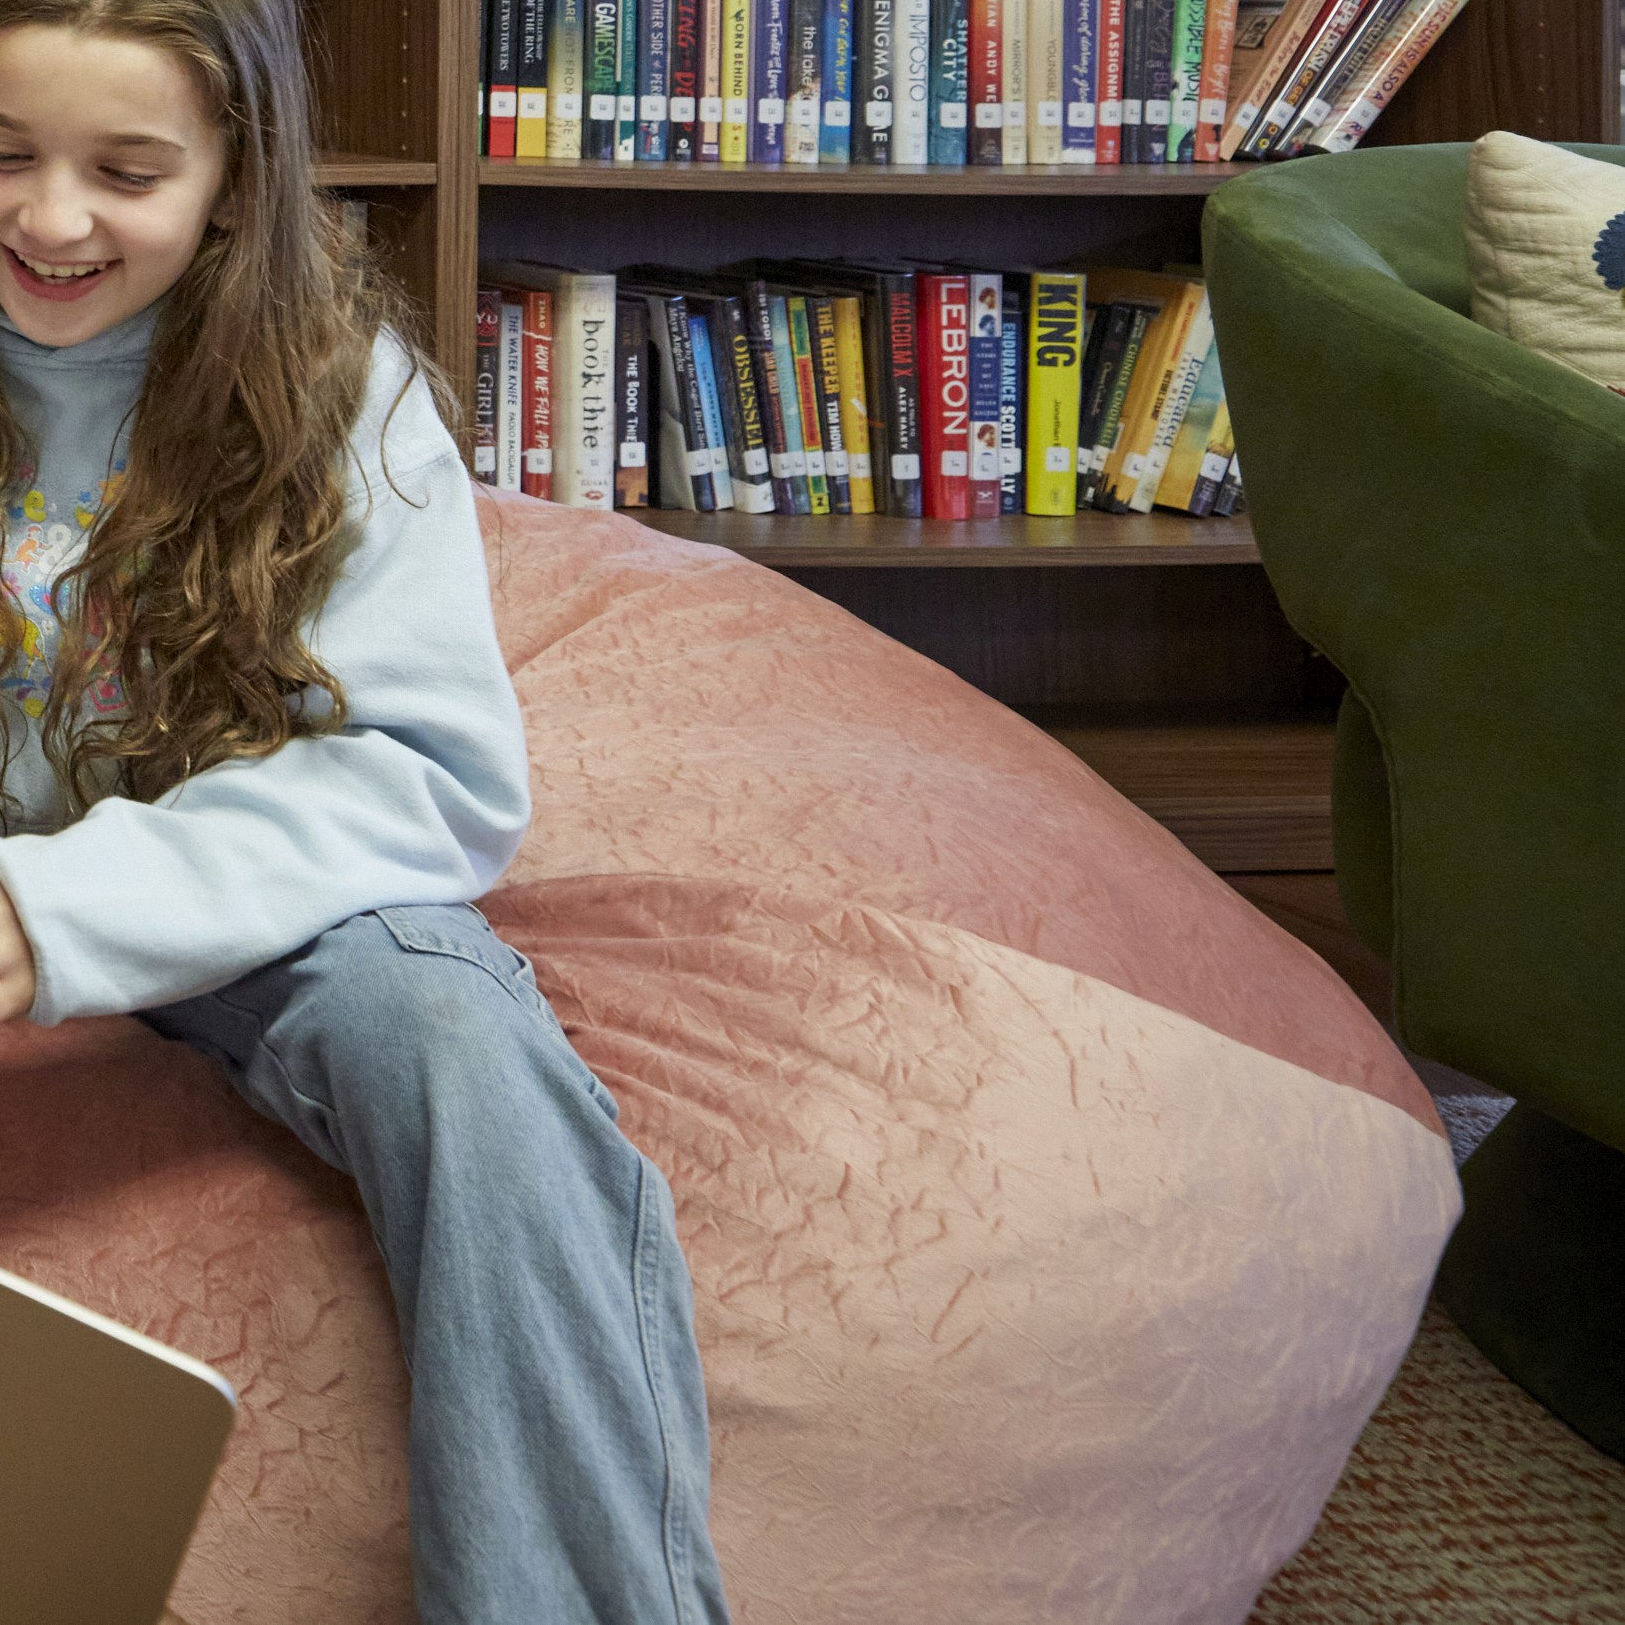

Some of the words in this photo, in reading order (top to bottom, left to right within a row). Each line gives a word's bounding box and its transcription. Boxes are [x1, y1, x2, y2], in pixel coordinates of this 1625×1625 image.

[501, 8, 510, 30] TWO
[526, 12, 535, 34] THE
[1109, 0, 1120, 24] THE
[652, 33, 663, 55] SIDE
[734, 17, 744, 49] BORN
[874, 0, 890, 79] ENIGMA
[500, 31, 509, 70] TOWERS
[524, 36, 534, 63] RING
[943, 39, 956, 80] CITY
[986, 40, 996, 75] ANDY
[734, 53, 744, 96] BEHIND
[508, 316, 518, 333] THE
[816, 306, 834, 332] THE
[891, 293, 911, 363] MALCOLM
[1037, 284, 1077, 367] KING
[508, 338, 518, 370] WATER
[535, 345, 548, 370] HOW
[583, 320, 604, 388] book
[627, 355, 637, 377] THE
[820, 338, 839, 394] KEEPER
[941, 283, 965, 435] LEBRON
[1002, 323, 1017, 401] ENDURANCE
[507, 375, 517, 405] KNIFE
[535, 377, 548, 393] WE
[626, 382, 638, 413] BOOK
[899, 387, 907, 413] ALEX
[535, 397, 549, 424] FALL
[899, 416, 908, 449] HALEY
